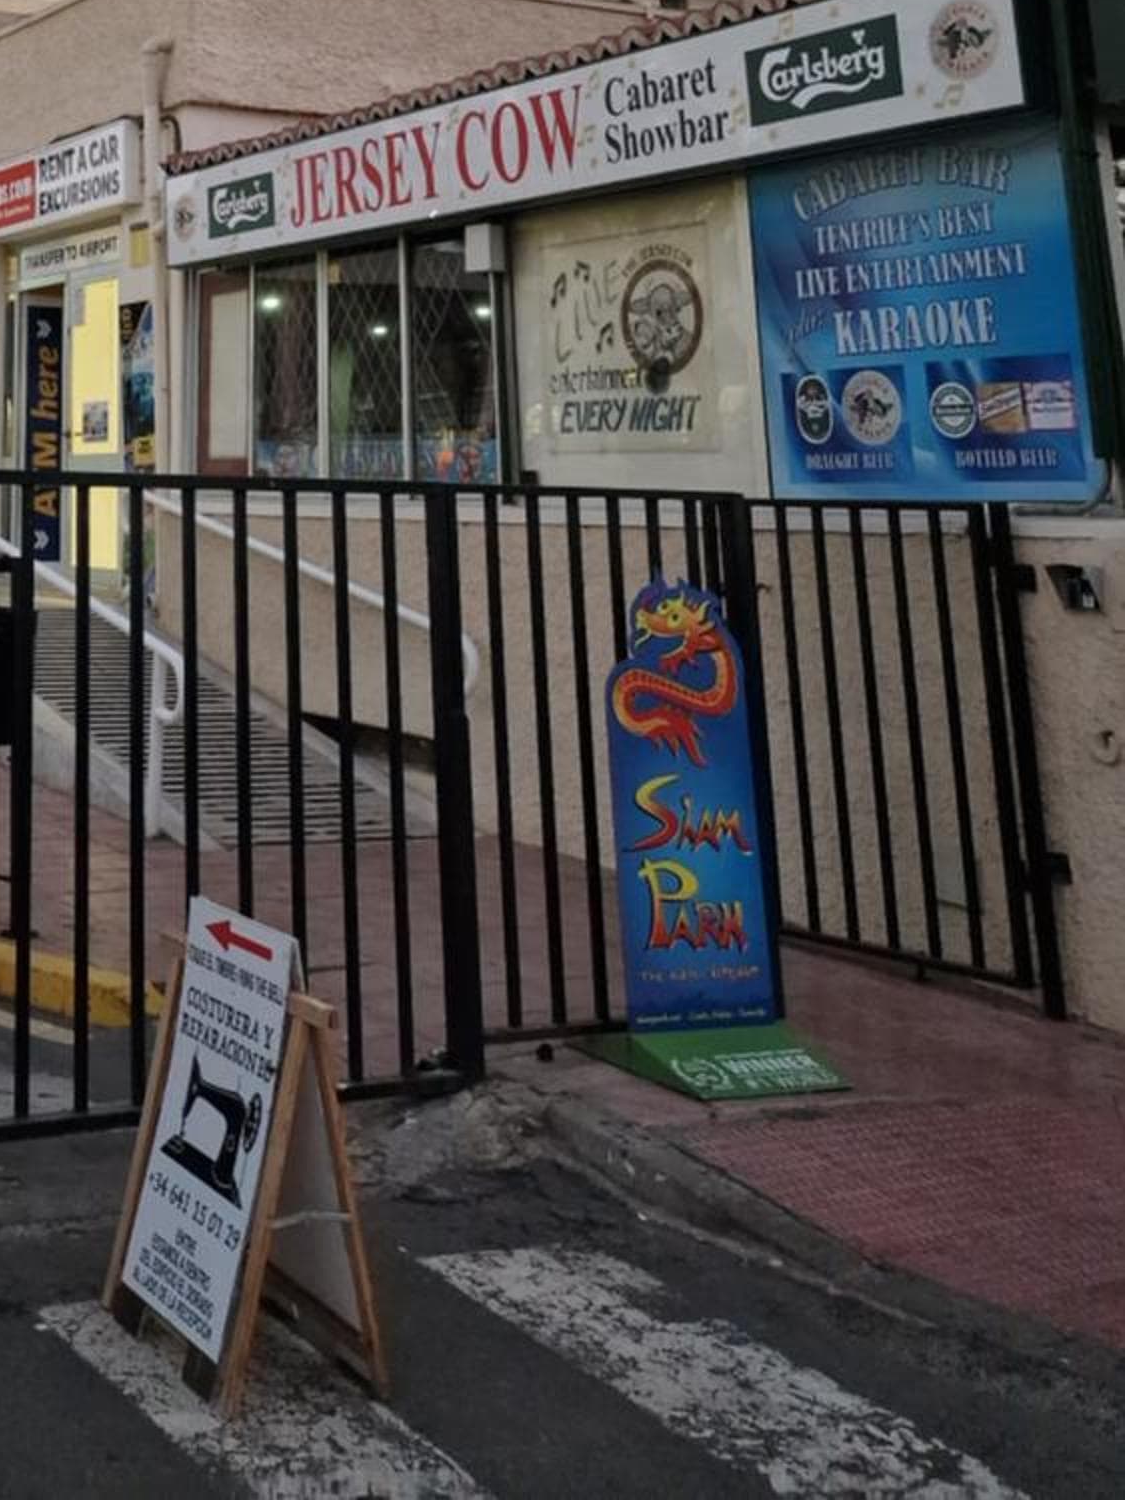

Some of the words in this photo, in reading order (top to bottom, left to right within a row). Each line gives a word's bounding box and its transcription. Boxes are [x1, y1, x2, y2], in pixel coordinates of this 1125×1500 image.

[604, 56, 716, 117] Cabaret
[759, 46, 886, 101] Carlsberg
[39, 148, 74, 183] RENT
[77, 146, 87, 171] A
[89, 134, 120, 167] CAR
[290, 121, 441, 229] JERSEY
[455, 84, 583, 192] COW
[604, 109, 729, 165] Showbar
[39, 169, 120, 216] EXCURSIONS
[213, 185, 269, 224] Carlsberg
[793, 148, 924, 222] CABARET
[937, 146, 1013, 195] BAR
[937, 201, 994, 240] BEST
[794, 267, 841, 299] LIVE
[845, 243, 1027, 293] ENTERTAINMENT
[833, 296, 997, 356] KARAOKE
[30, 345, 60, 421] here
[560, 398, 626, 434] EVERY
[629, 395, 702, 433] NIGHT
[32, 431, 59, 517] AM
[187, 986, 260, 1044] COSTURERA
[263, 1024, 274, 1051] Y
